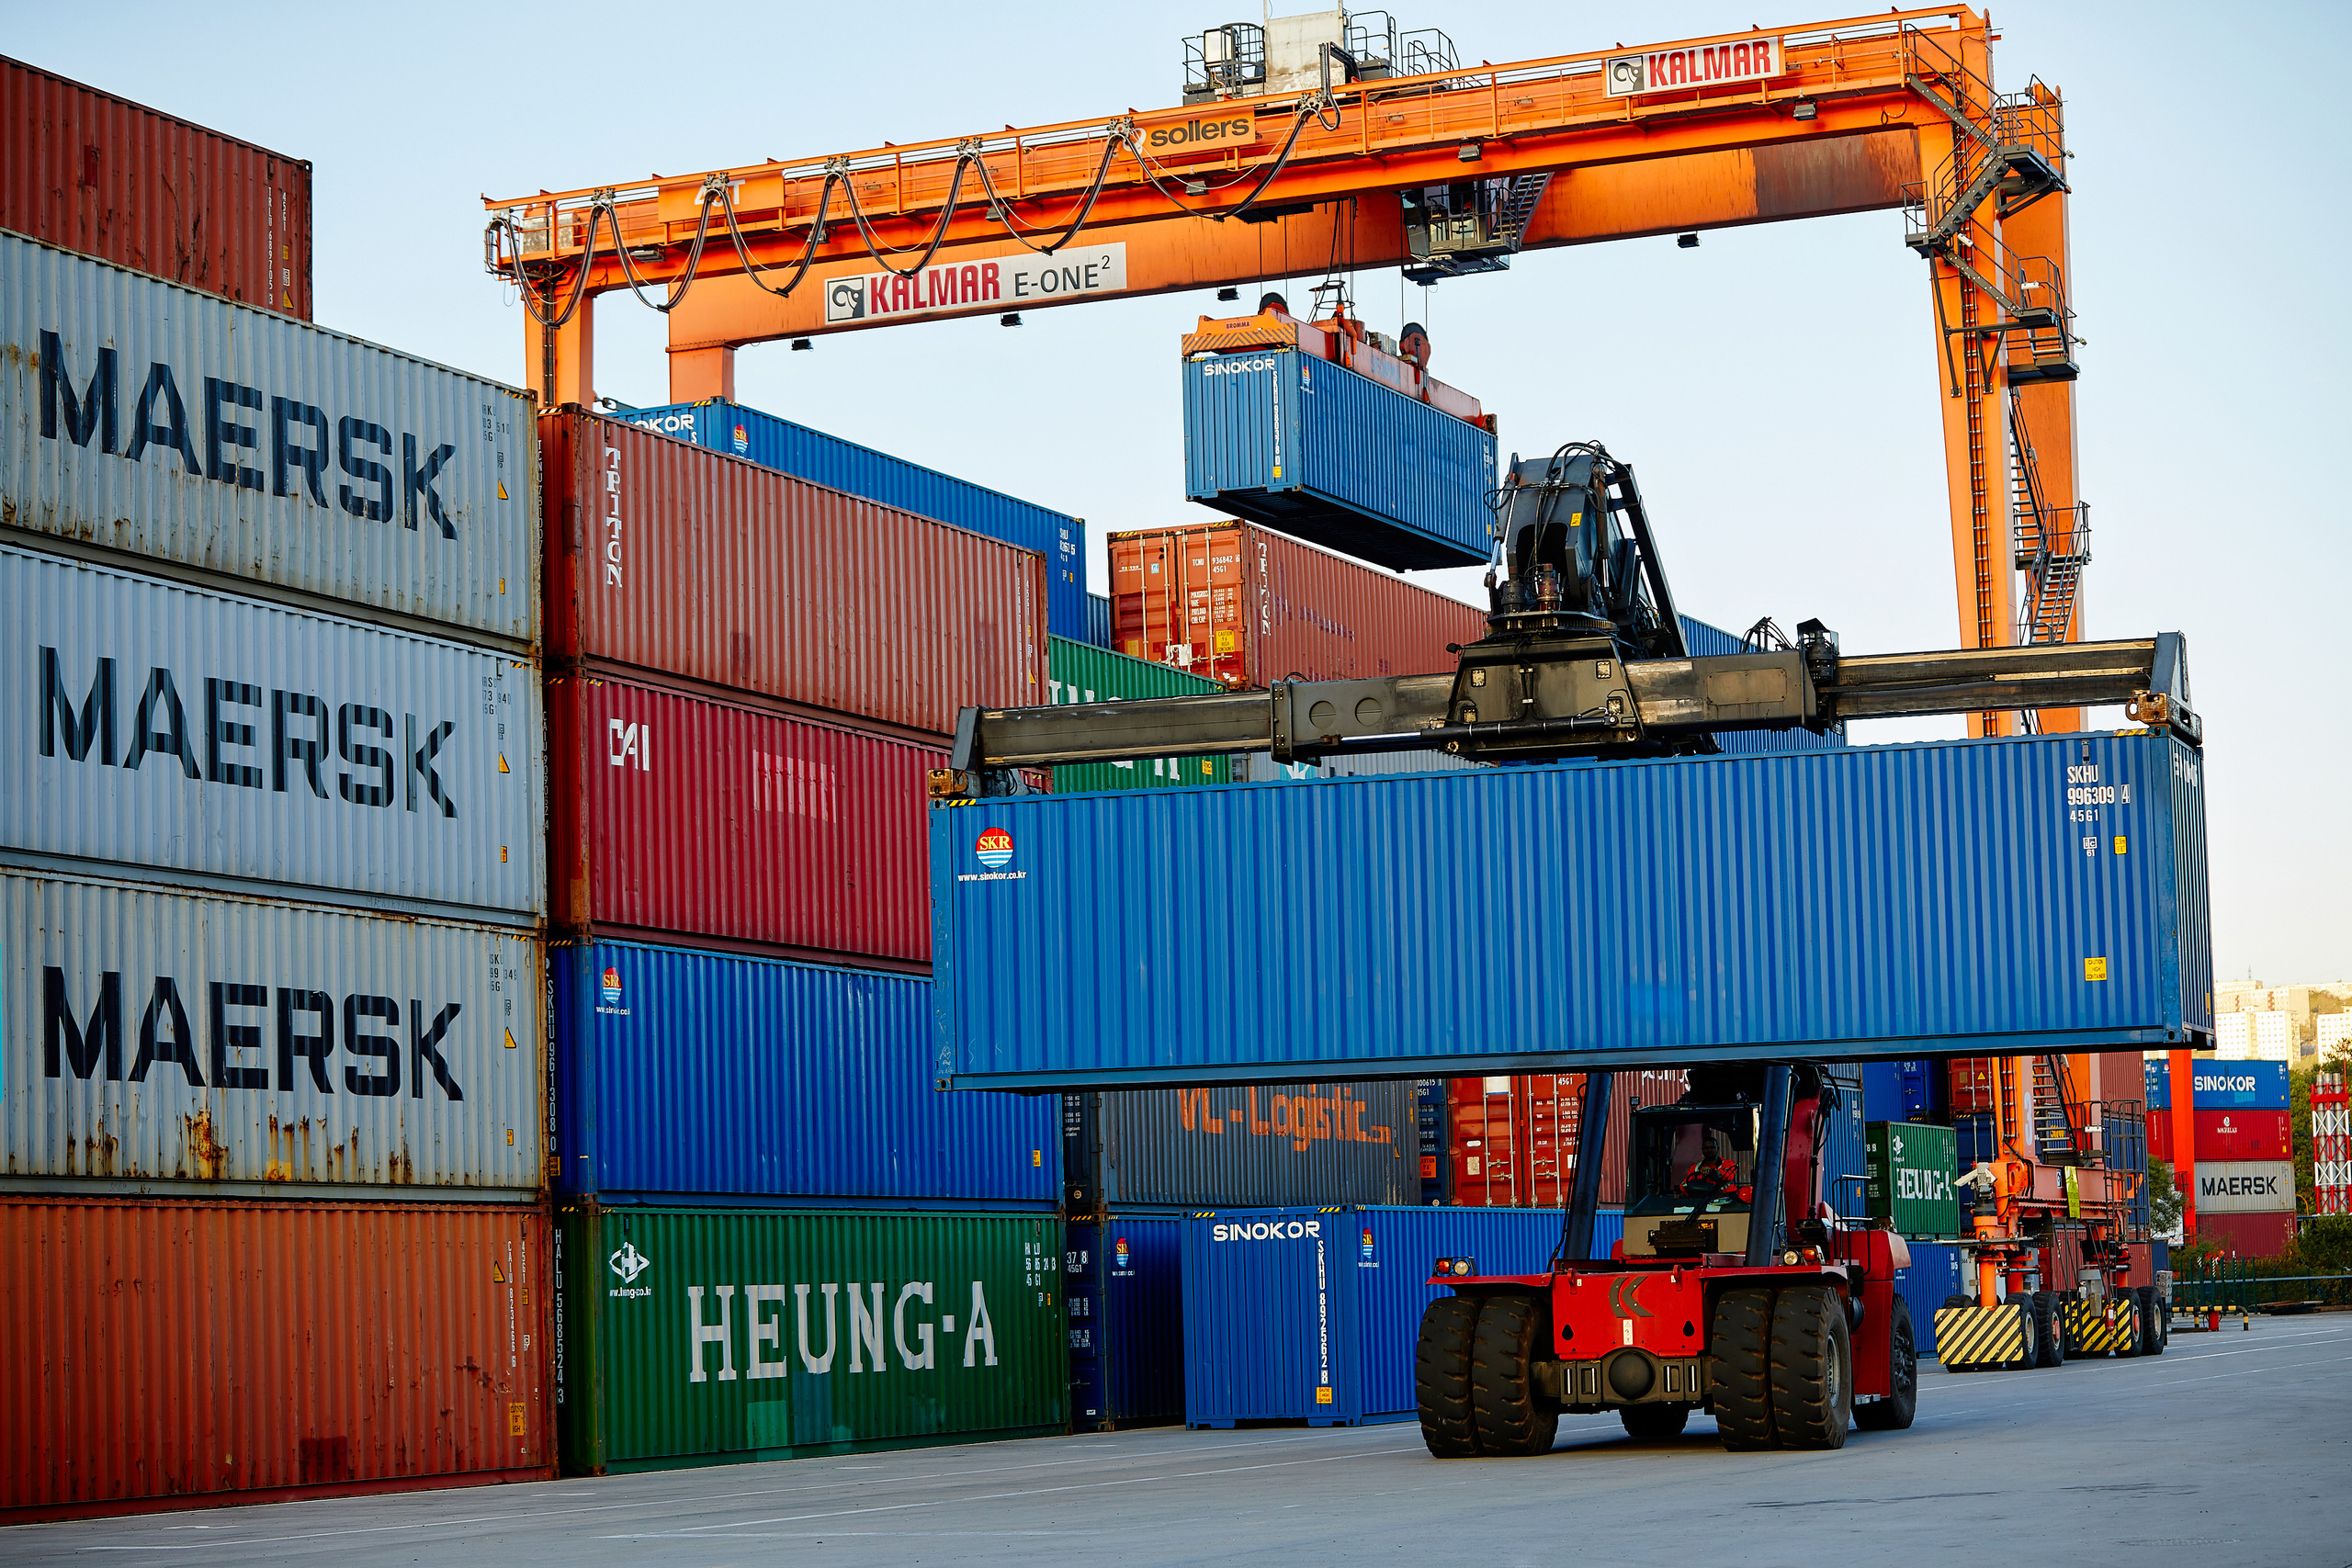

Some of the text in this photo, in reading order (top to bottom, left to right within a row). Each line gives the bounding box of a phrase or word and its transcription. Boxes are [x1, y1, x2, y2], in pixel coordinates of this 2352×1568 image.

[1649, 40, 1771, 87] KALMAR
[1150, 118, 1250, 148] sollers
[870, 262, 1001, 314] KALMAR
[1226, 321, 1250, 330] BROMMA
[1204, 358, 1276, 377] SINOKOR
[40, 328, 458, 540] MAERSK
[605, 446, 623, 588] TRITON
[1212, 555, 1233, 565] 936842
[1212, 565, 1227, 573] 45G1
[39, 644, 458, 819] MAERSK
[609, 717, 650, 772] CAI
[2066, 764, 2098, 784] SKHU
[2067, 784, 2130, 806] 996309 4
[2069, 808, 2098, 823] 45G1
[979, 835, 1011, 851] SKR
[2086, 849, 2096, 857] 61
[957, 870, 1027, 882] www.sinokor.co.kr
[43, 965, 464, 1101] MAERSK
[2194, 1076, 2256, 1091] SINOKOR
[2024, 1091, 2032, 1146] 3
[2201, 1177, 2278, 1196] MAERSK
[1213, 1221, 1320, 1242] SINOKOR
[1317, 1240, 1329, 1383] SKHU 892562 8
[687, 1280, 998, 1382] HEUNG-A
[558, 1388, 564, 1404] 3
